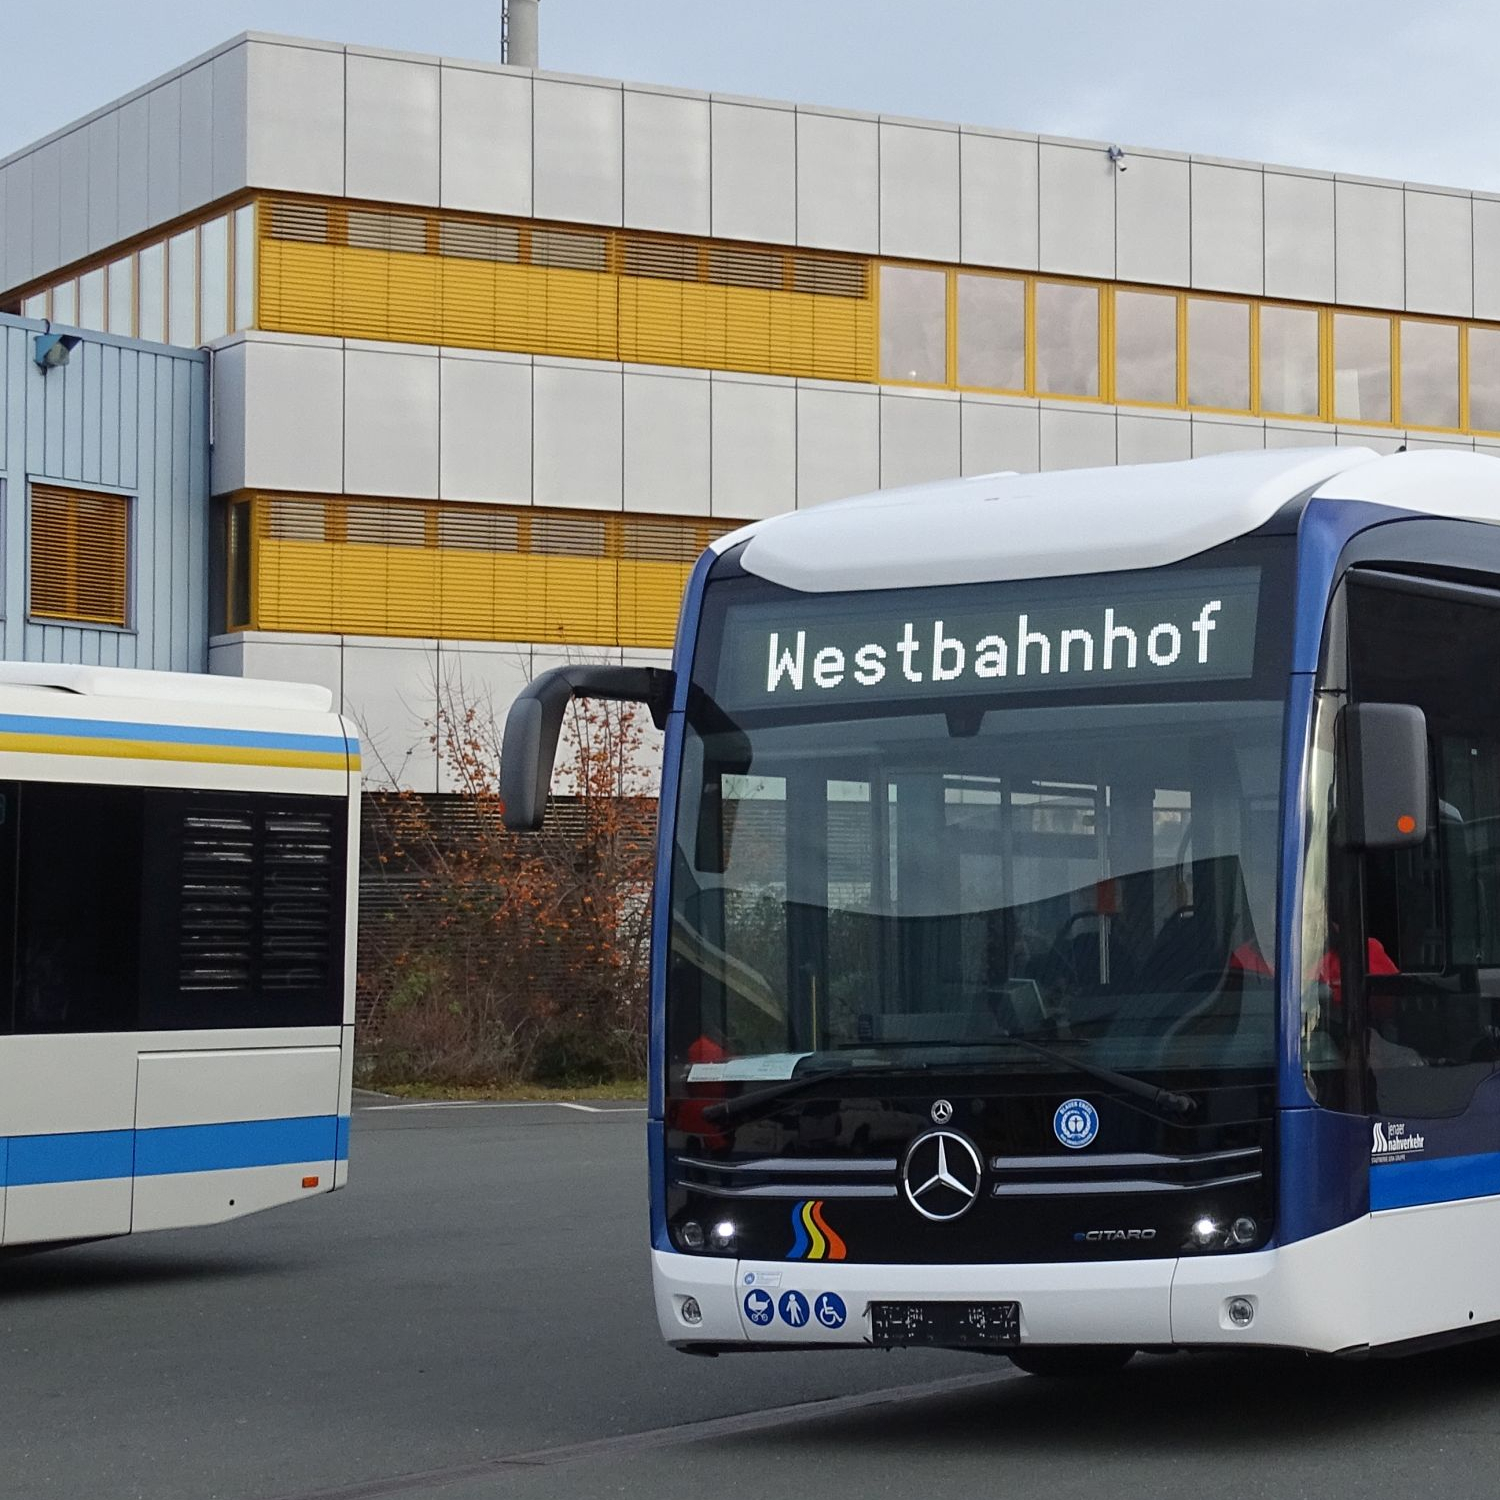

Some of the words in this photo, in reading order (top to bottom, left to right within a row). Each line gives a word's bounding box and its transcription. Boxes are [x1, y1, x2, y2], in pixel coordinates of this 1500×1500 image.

[766, 599, 1222, 692] Westbahnhof
[1388, 1122, 1405, 1139] jenaer
[1388, 1133, 1424, 1151] nahverkehr
